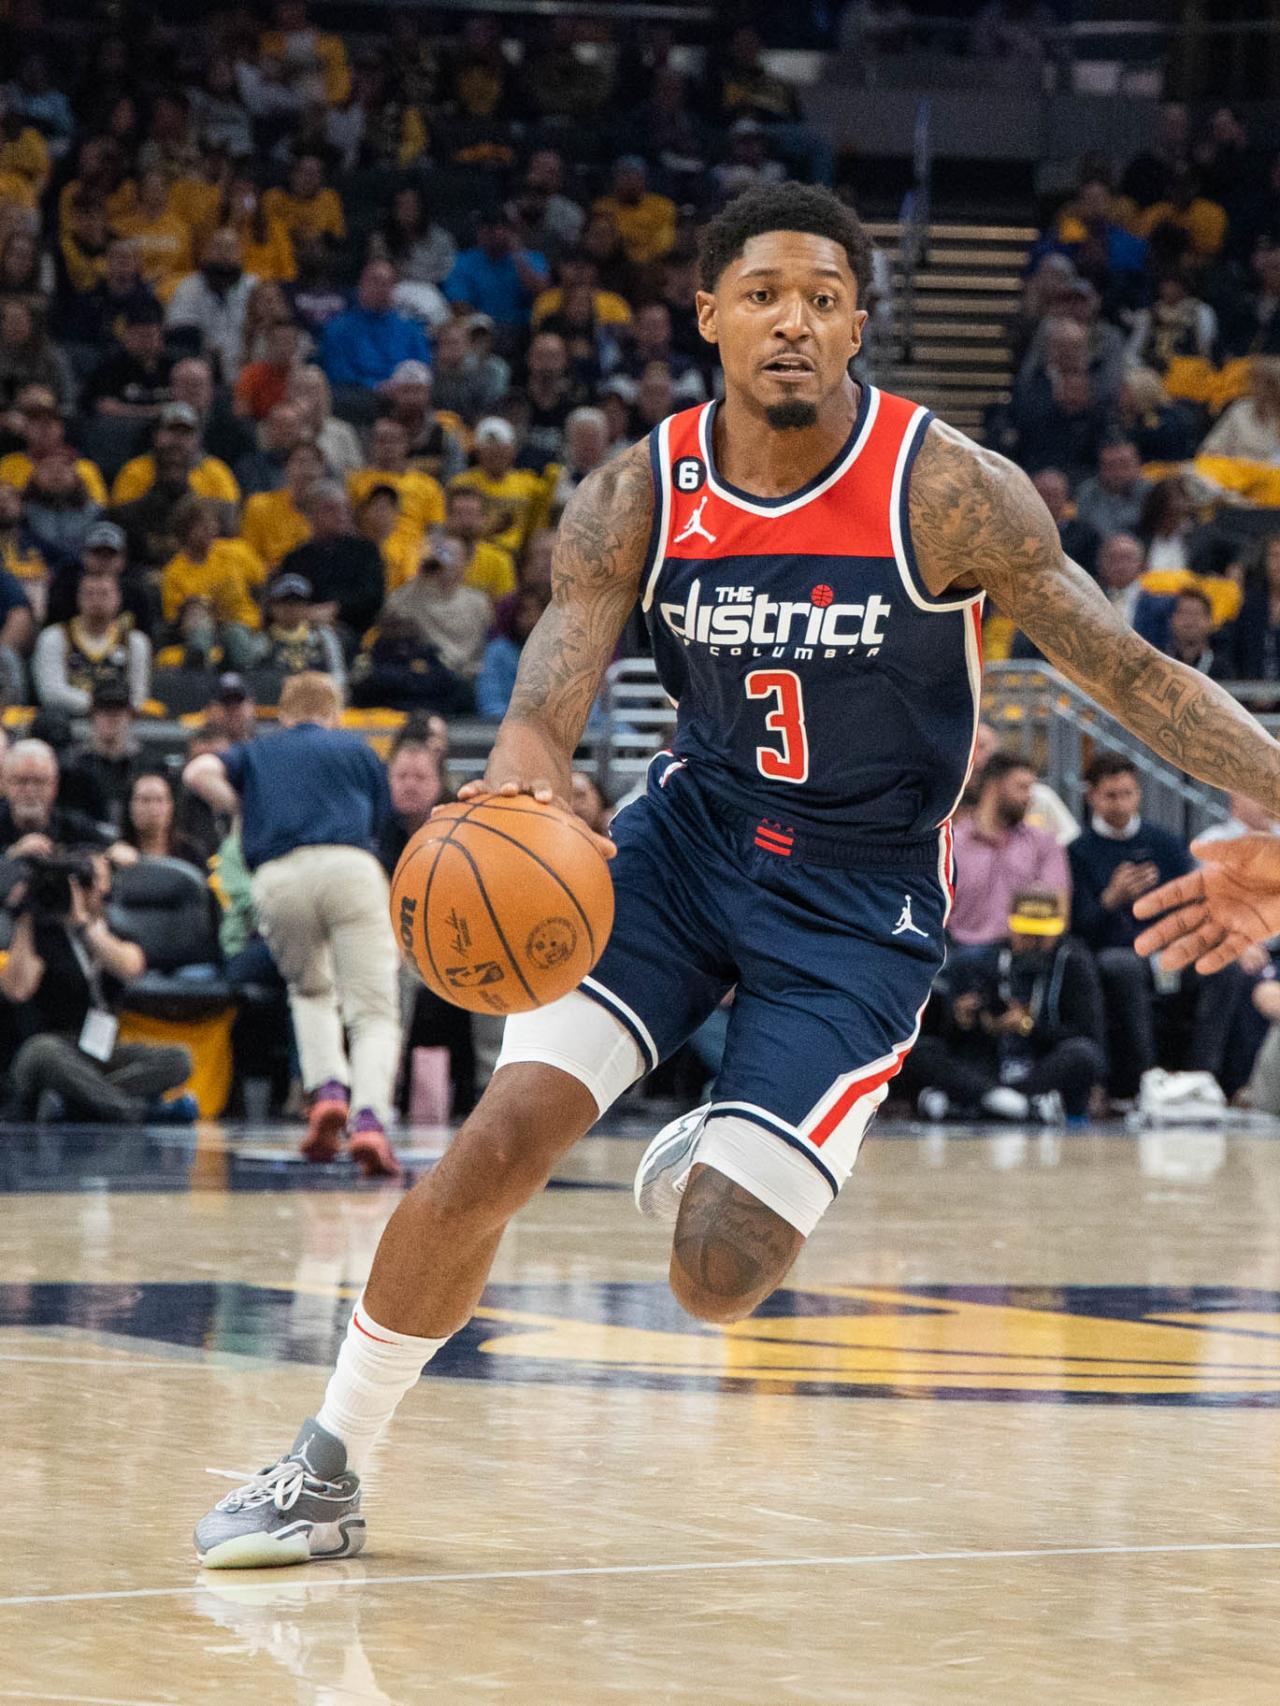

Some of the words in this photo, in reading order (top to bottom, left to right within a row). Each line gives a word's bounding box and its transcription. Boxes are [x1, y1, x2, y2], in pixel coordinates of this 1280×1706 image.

[678, 461, 699, 490] 6
[660, 578, 891, 645] district
[715, 586, 755, 603] THE
[744, 669, 809, 784] 3
